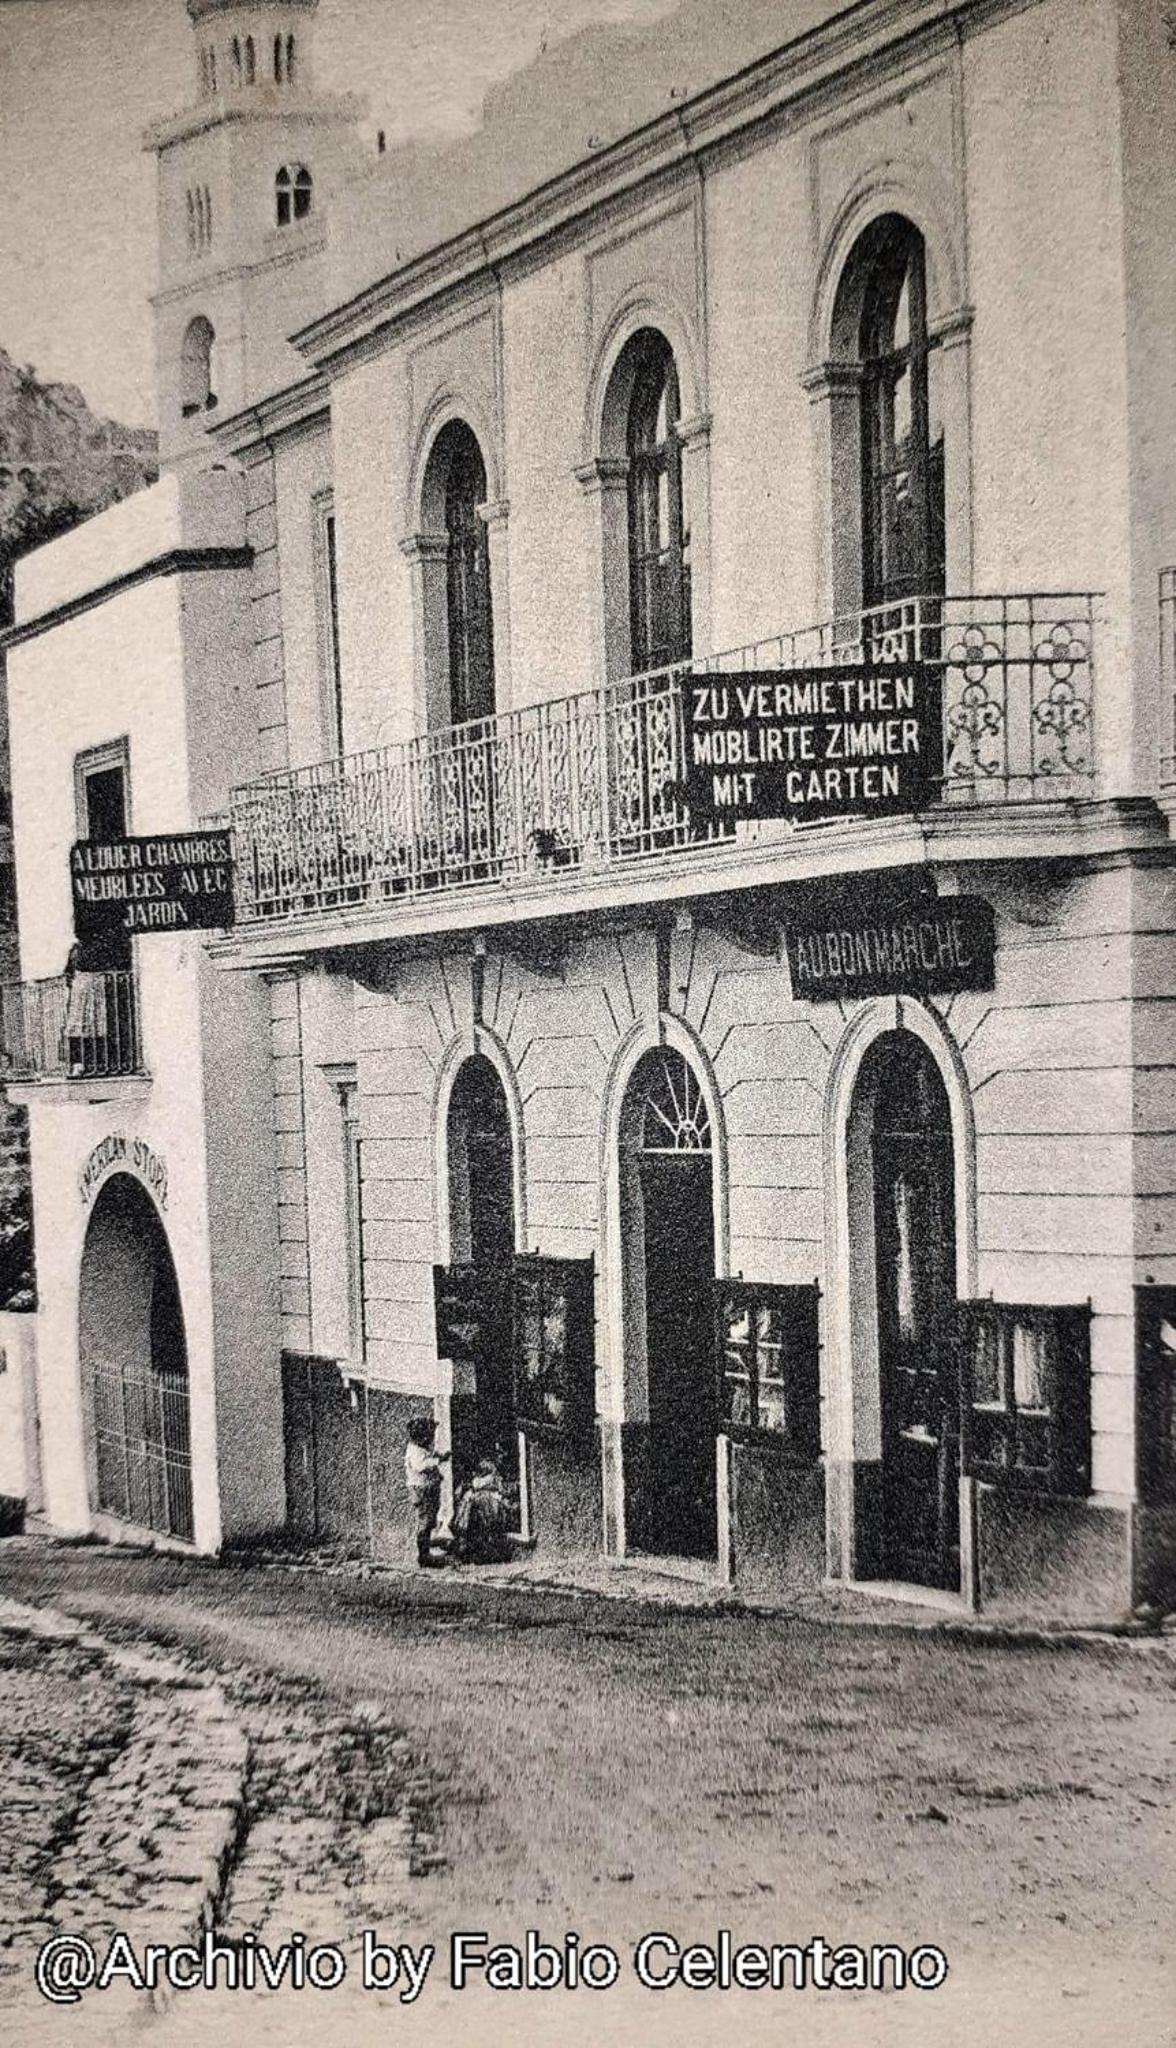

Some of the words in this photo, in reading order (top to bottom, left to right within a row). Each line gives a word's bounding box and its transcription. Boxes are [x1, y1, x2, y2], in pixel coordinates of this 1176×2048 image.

[693, 687, 729, 721] ZU
[736, 677, 914, 718] VERMIETHEN
[693, 725, 816, 765] MOBLIRTE
[825, 719, 920, 759] ZIMMER
[713, 773, 756, 806] MIT
[786, 765, 900, 803] GARTEN
[87, 844, 142, 871] LOUER
[146, 839, 227, 866] CHAMBRES
[179, 868, 227, 895] AVEC
[123, 901, 188, 928] JARDIN
